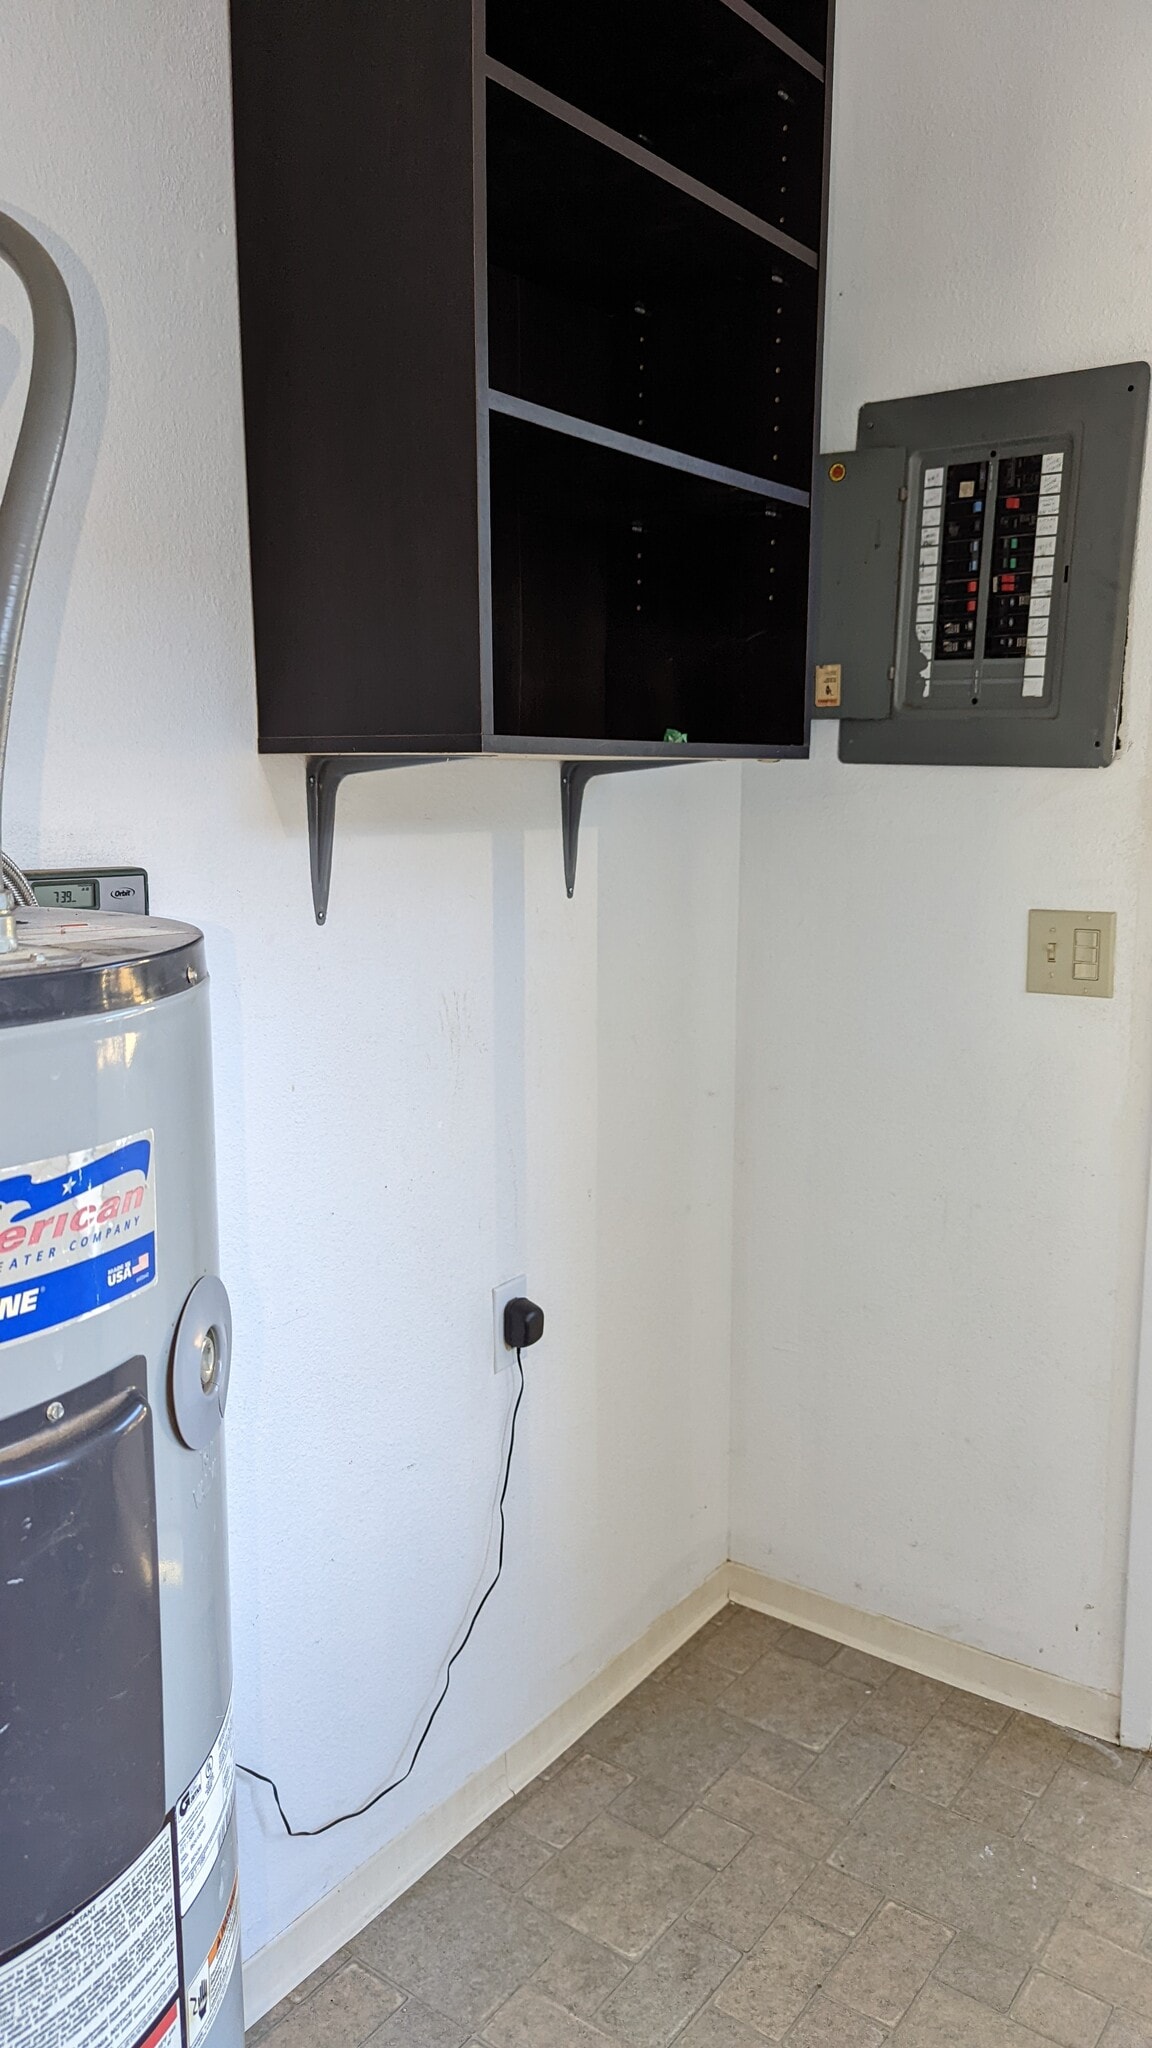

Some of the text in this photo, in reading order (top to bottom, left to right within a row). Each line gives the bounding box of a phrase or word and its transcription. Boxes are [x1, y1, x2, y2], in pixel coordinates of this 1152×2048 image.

[114, 889, 131, 898] Orbit
[0, 1185, 146, 1253] erican
[69, 1216, 141, 1252] COMPANY
[107, 1266, 132, 1287] USA
[55, 1903, 97, 1941] IMPORTANT
